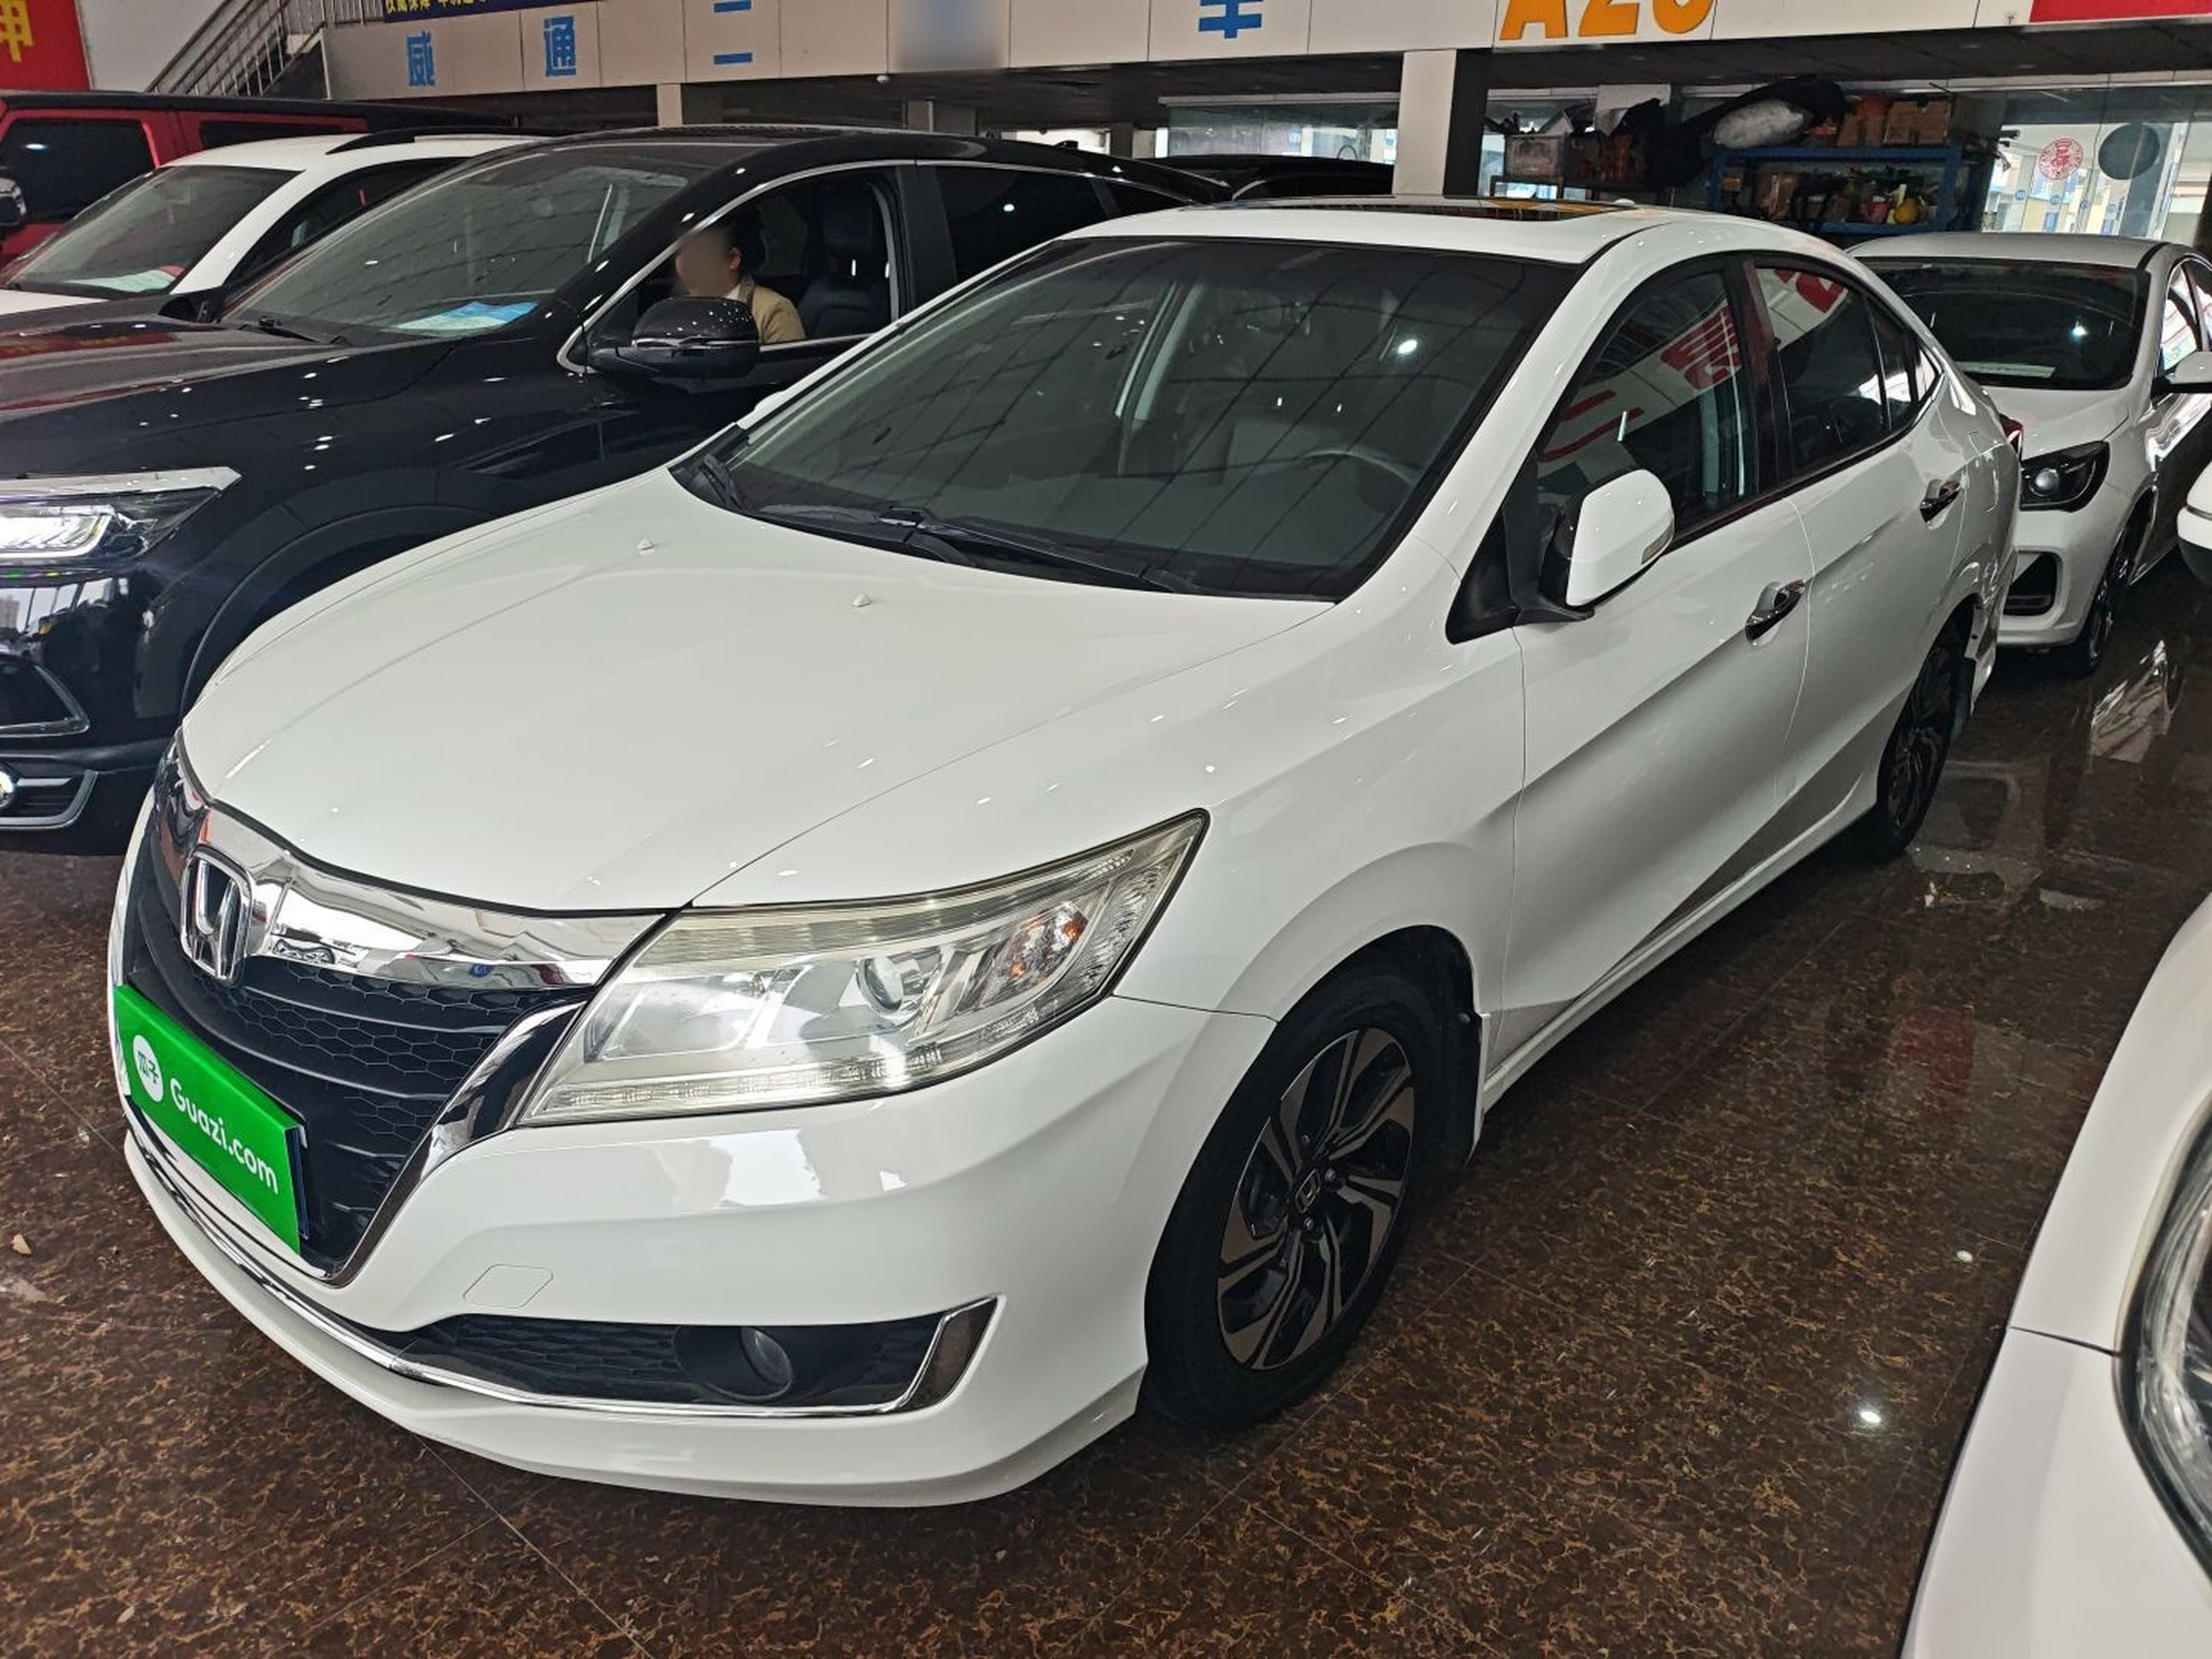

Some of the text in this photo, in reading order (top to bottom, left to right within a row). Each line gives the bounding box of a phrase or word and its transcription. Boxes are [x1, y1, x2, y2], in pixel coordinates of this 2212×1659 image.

[407, 31, 435, 86] 威
[544, 16, 577, 77] 通
[170, 1078, 279, 1194] Guazi.com
